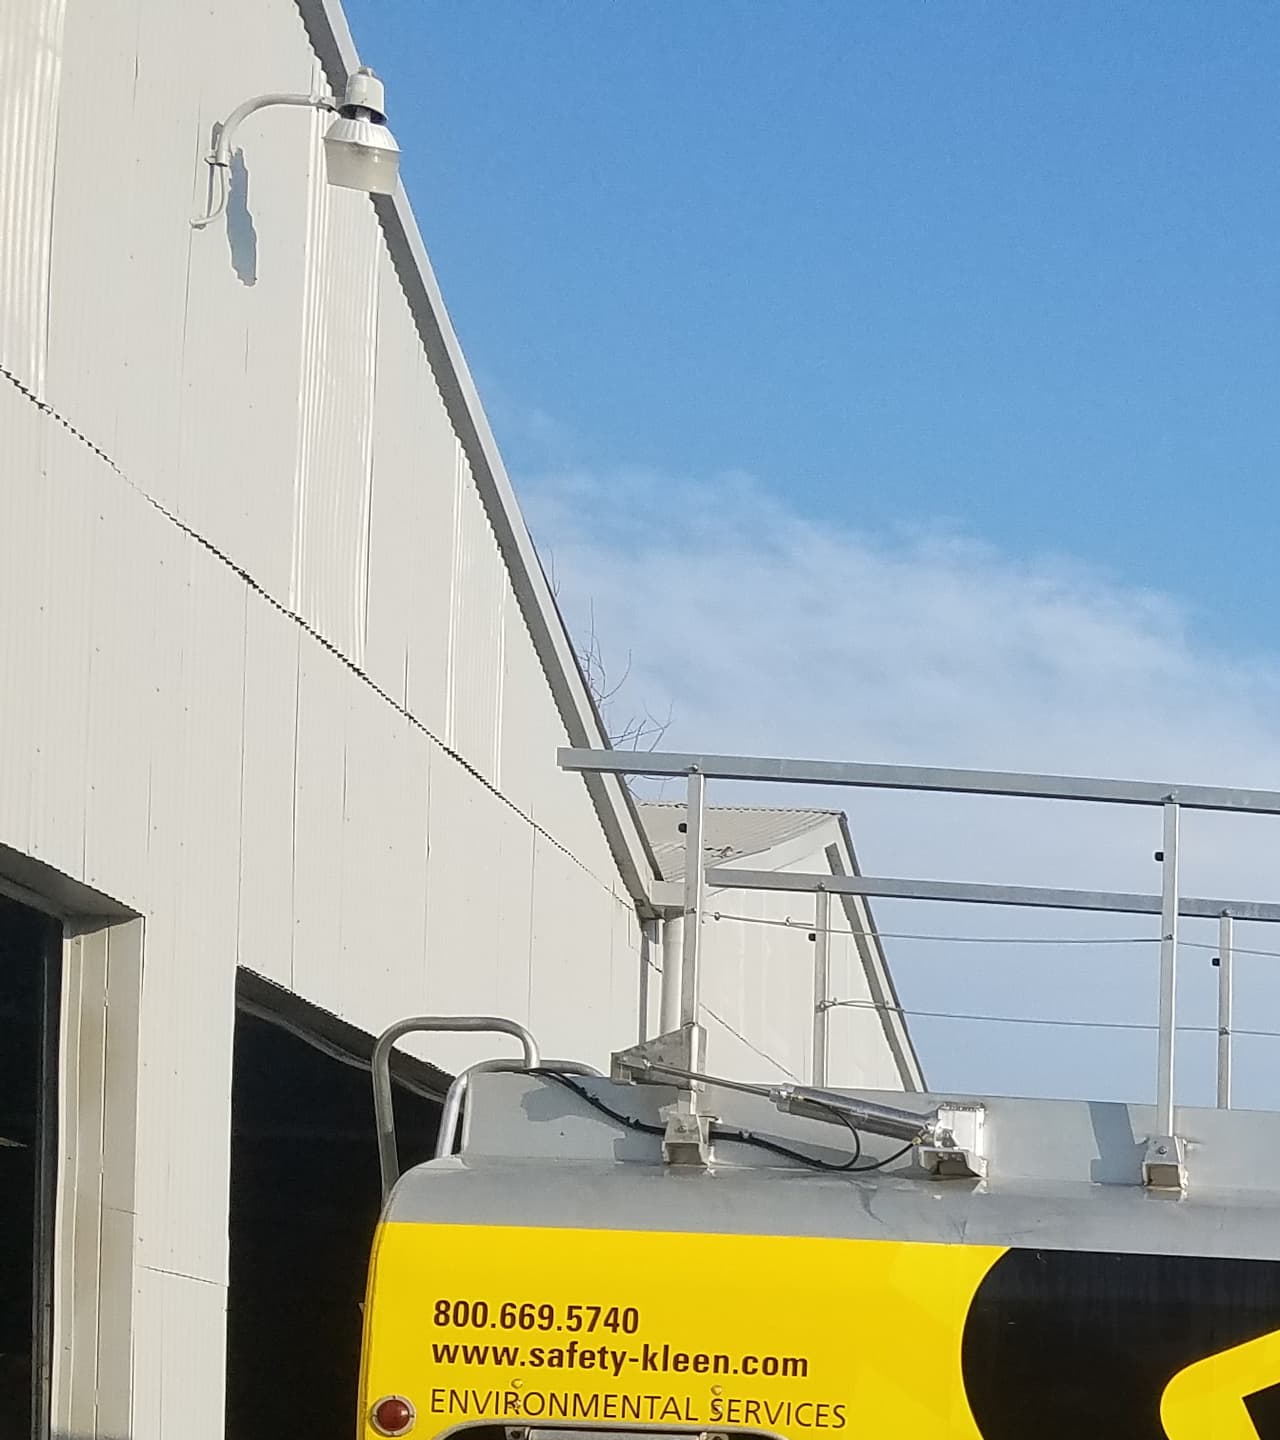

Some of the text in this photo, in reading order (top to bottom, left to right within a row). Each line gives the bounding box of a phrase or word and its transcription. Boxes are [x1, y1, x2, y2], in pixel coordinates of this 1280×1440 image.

[433, 1300, 640, 1334] 800.669.5740
[431, 1341, 809, 1377] www.safety-kleen.com
[430, 1388, 847, 1429] ENVIRONMENTAL SERVICES
